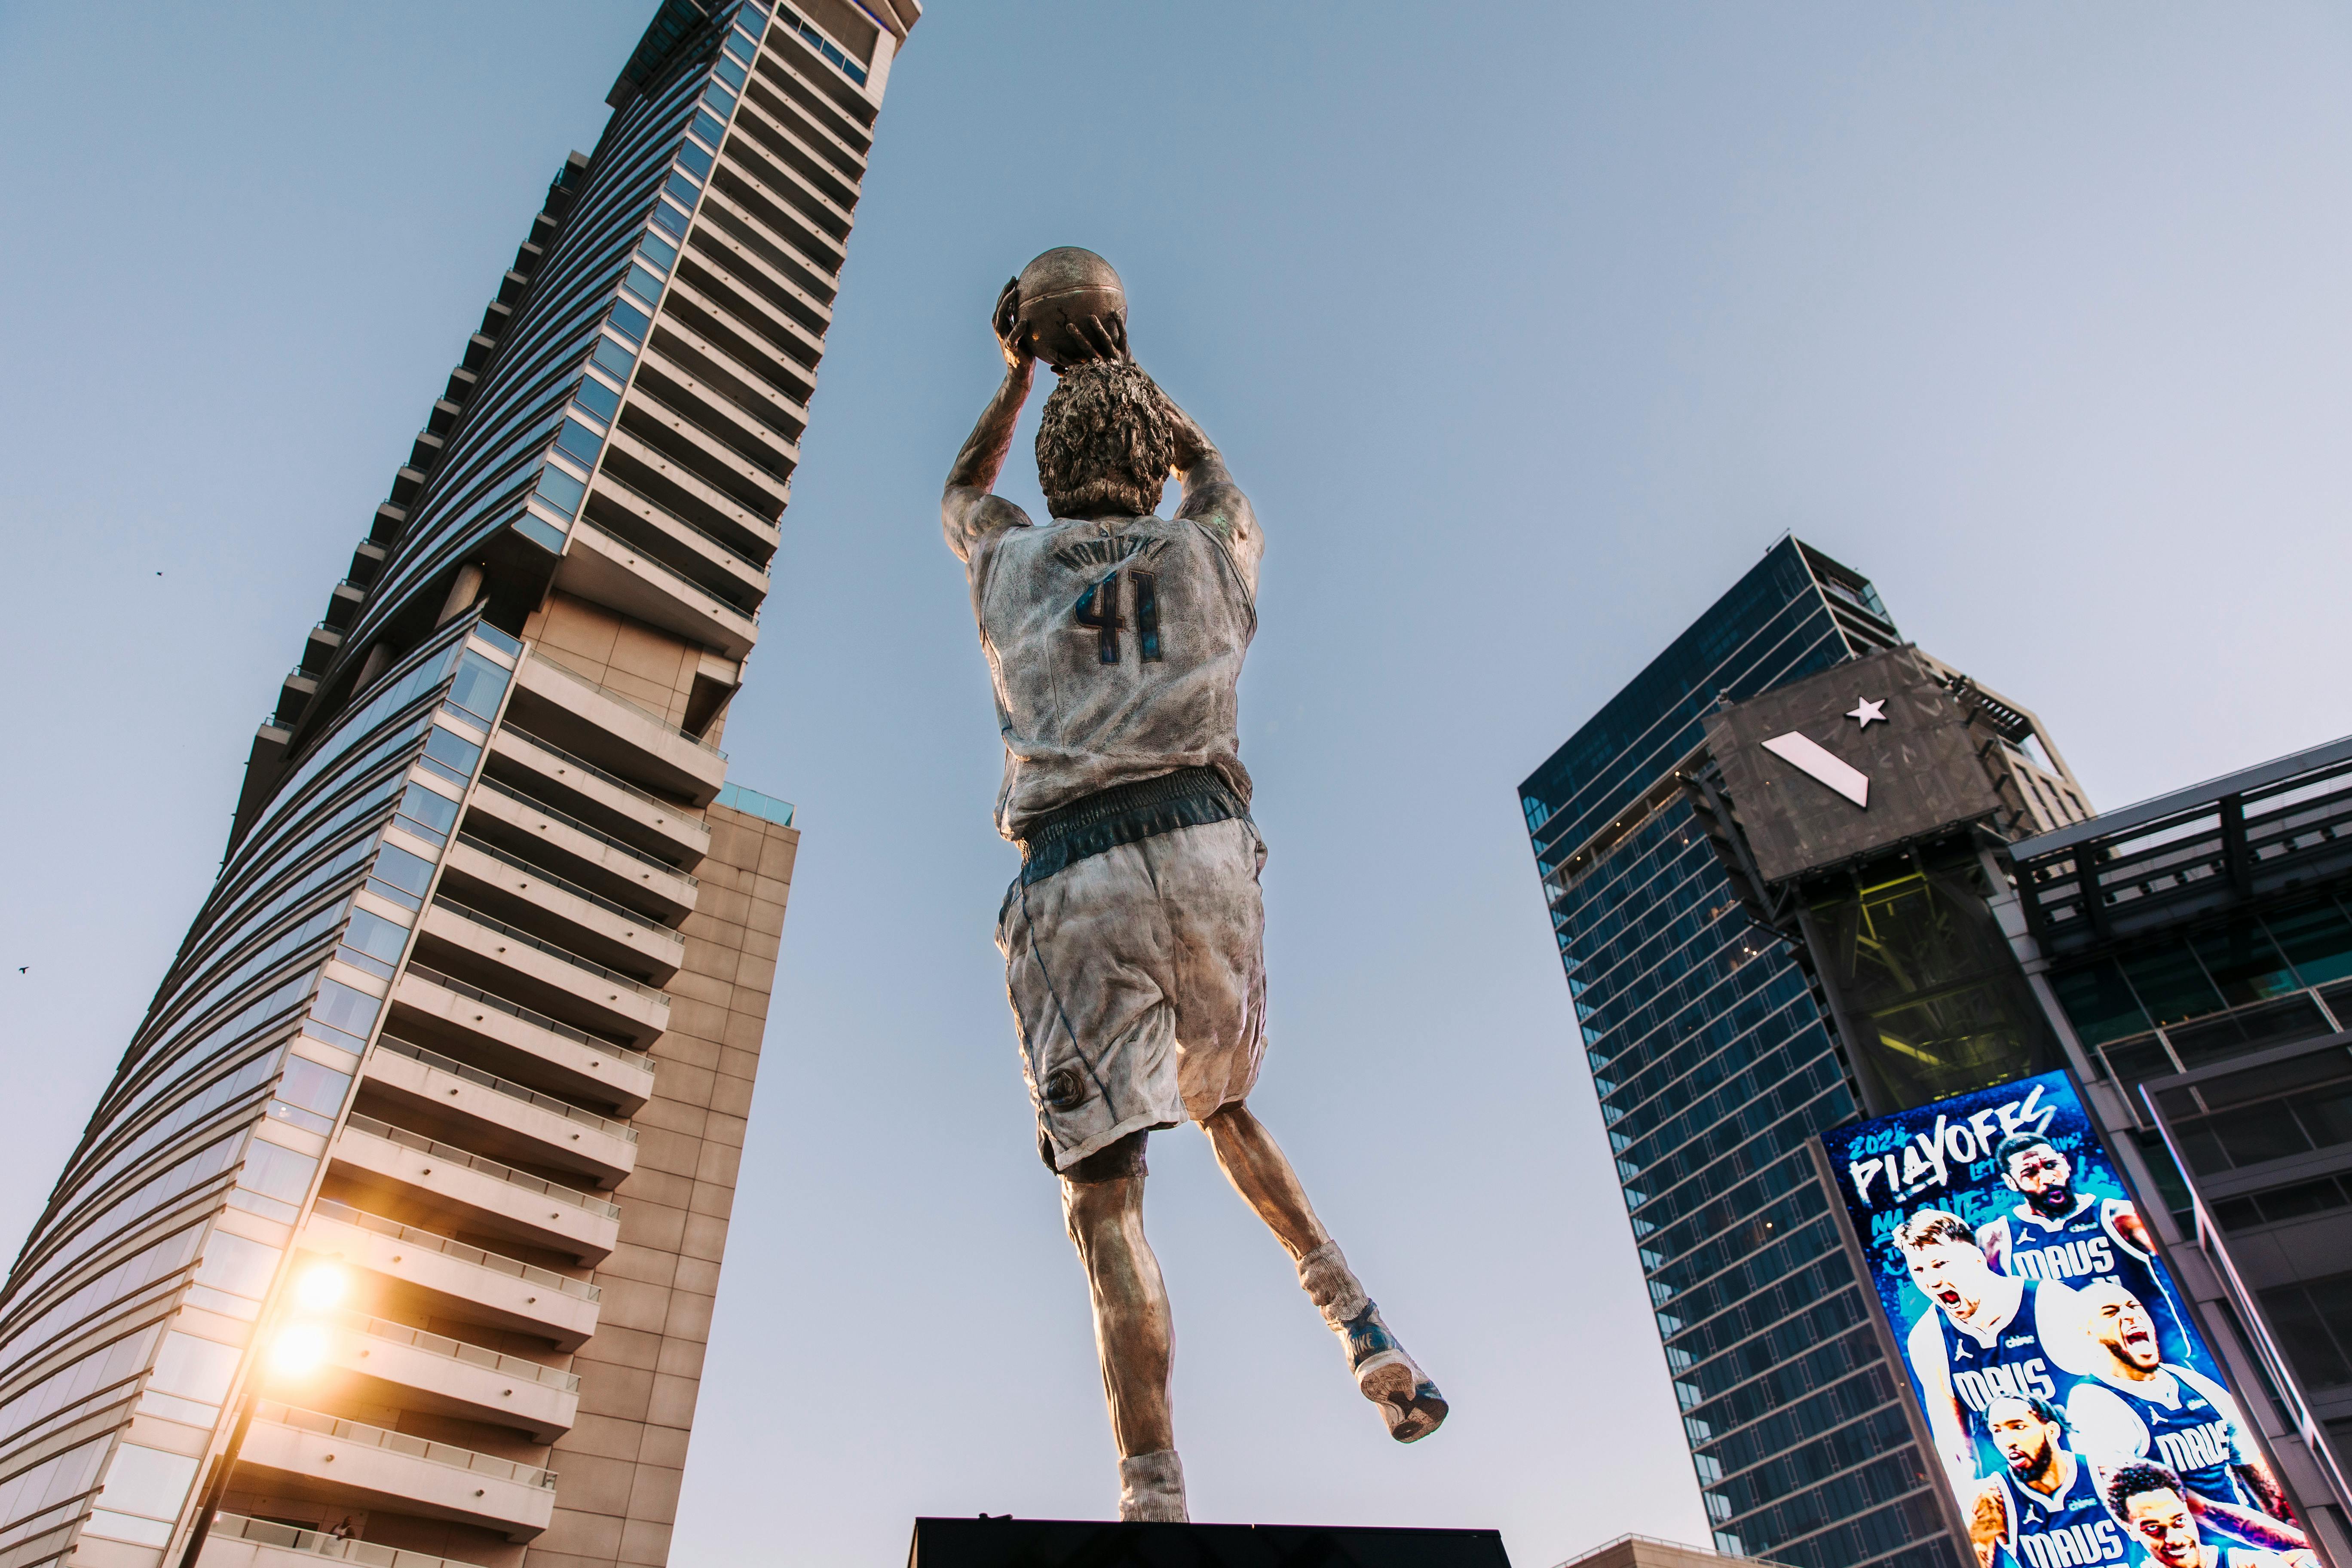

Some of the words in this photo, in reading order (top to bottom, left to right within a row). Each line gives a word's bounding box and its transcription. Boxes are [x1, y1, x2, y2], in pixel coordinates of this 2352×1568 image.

[1054, 535, 1169, 572] NOWITZKI
[1075, 569, 1161, 665] 41
[1849, 1084, 2057, 1206] PLAYOFFS
[1349, 1332, 1375, 1356] NIKE
